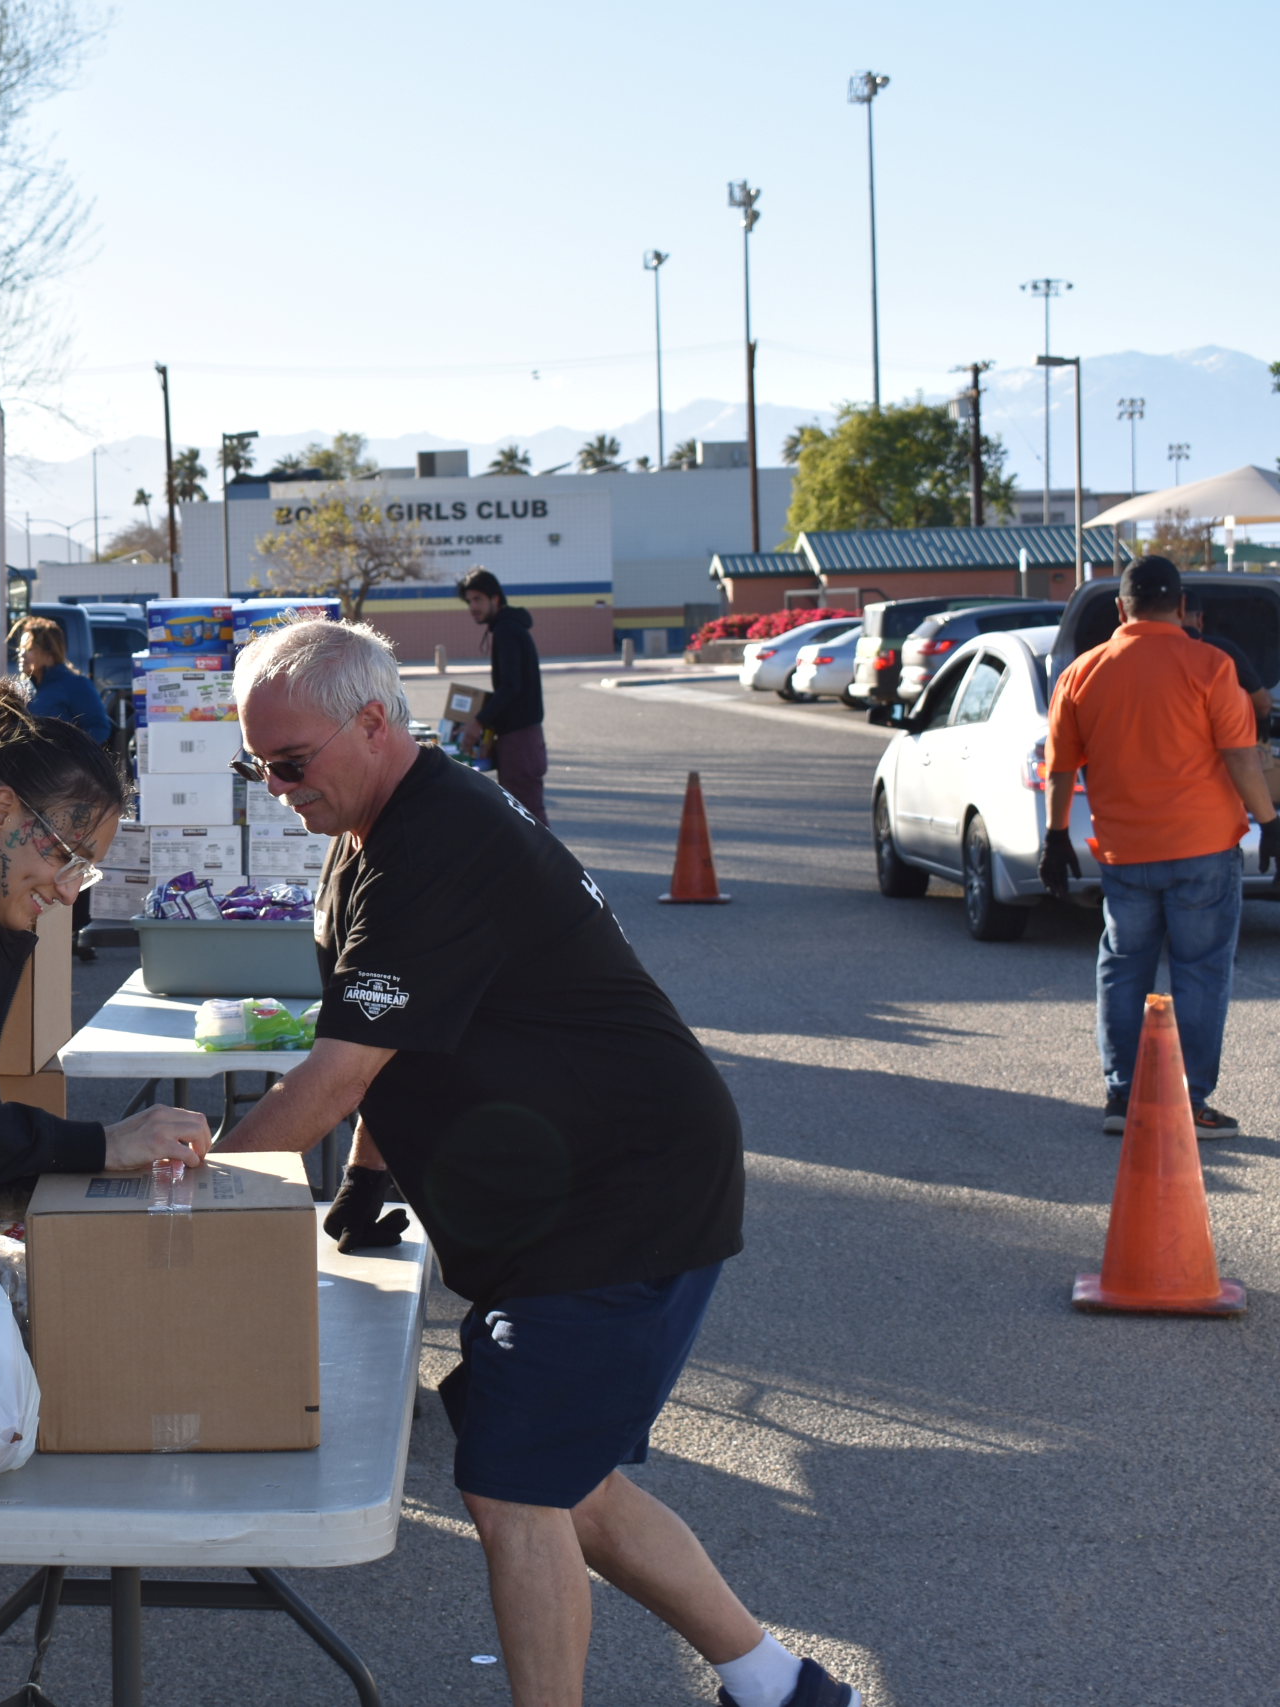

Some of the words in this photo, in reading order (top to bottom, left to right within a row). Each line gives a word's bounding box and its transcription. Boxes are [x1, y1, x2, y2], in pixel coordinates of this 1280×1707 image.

[386, 502, 467, 522] GIRLS
[476, 500, 548, 520] CLUB
[418, 536, 452, 546] TASK
[458, 534, 503, 545] FORCE
[358, 970, 391, 980] Sponsored
[346, 988, 406, 1006] ARROWHEAD
